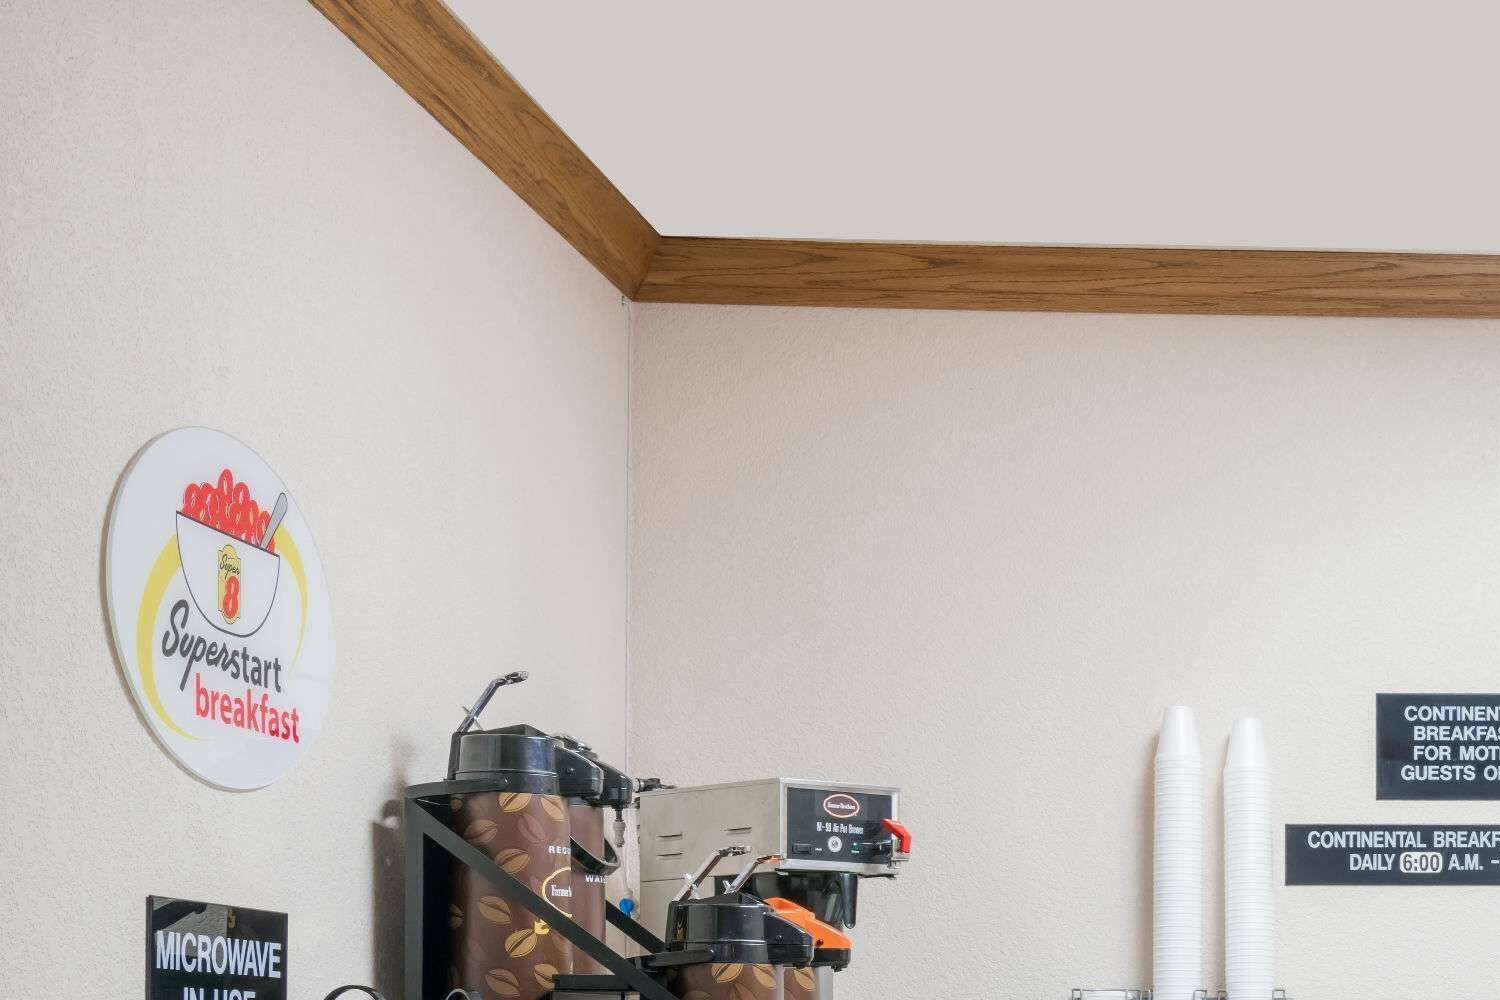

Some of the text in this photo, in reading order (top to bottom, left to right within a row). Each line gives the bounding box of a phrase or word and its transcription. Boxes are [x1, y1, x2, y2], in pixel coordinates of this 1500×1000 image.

[223, 575, 240, 619] 8
[161, 599, 283, 693] Superstart
[194, 672, 301, 744] breakfast
[1413, 745, 1451, 761] FOR
[1400, 765, 1476, 781] GUESTS
[1307, 830, 1427, 849] CONTINENTAL
[1349, 853, 1396, 871] DAILY
[1402, 853, 1442, 872] 6:00
[1448, 853, 1484, 871] A.M.
[155, 930, 282, 979] MICROWAVE
